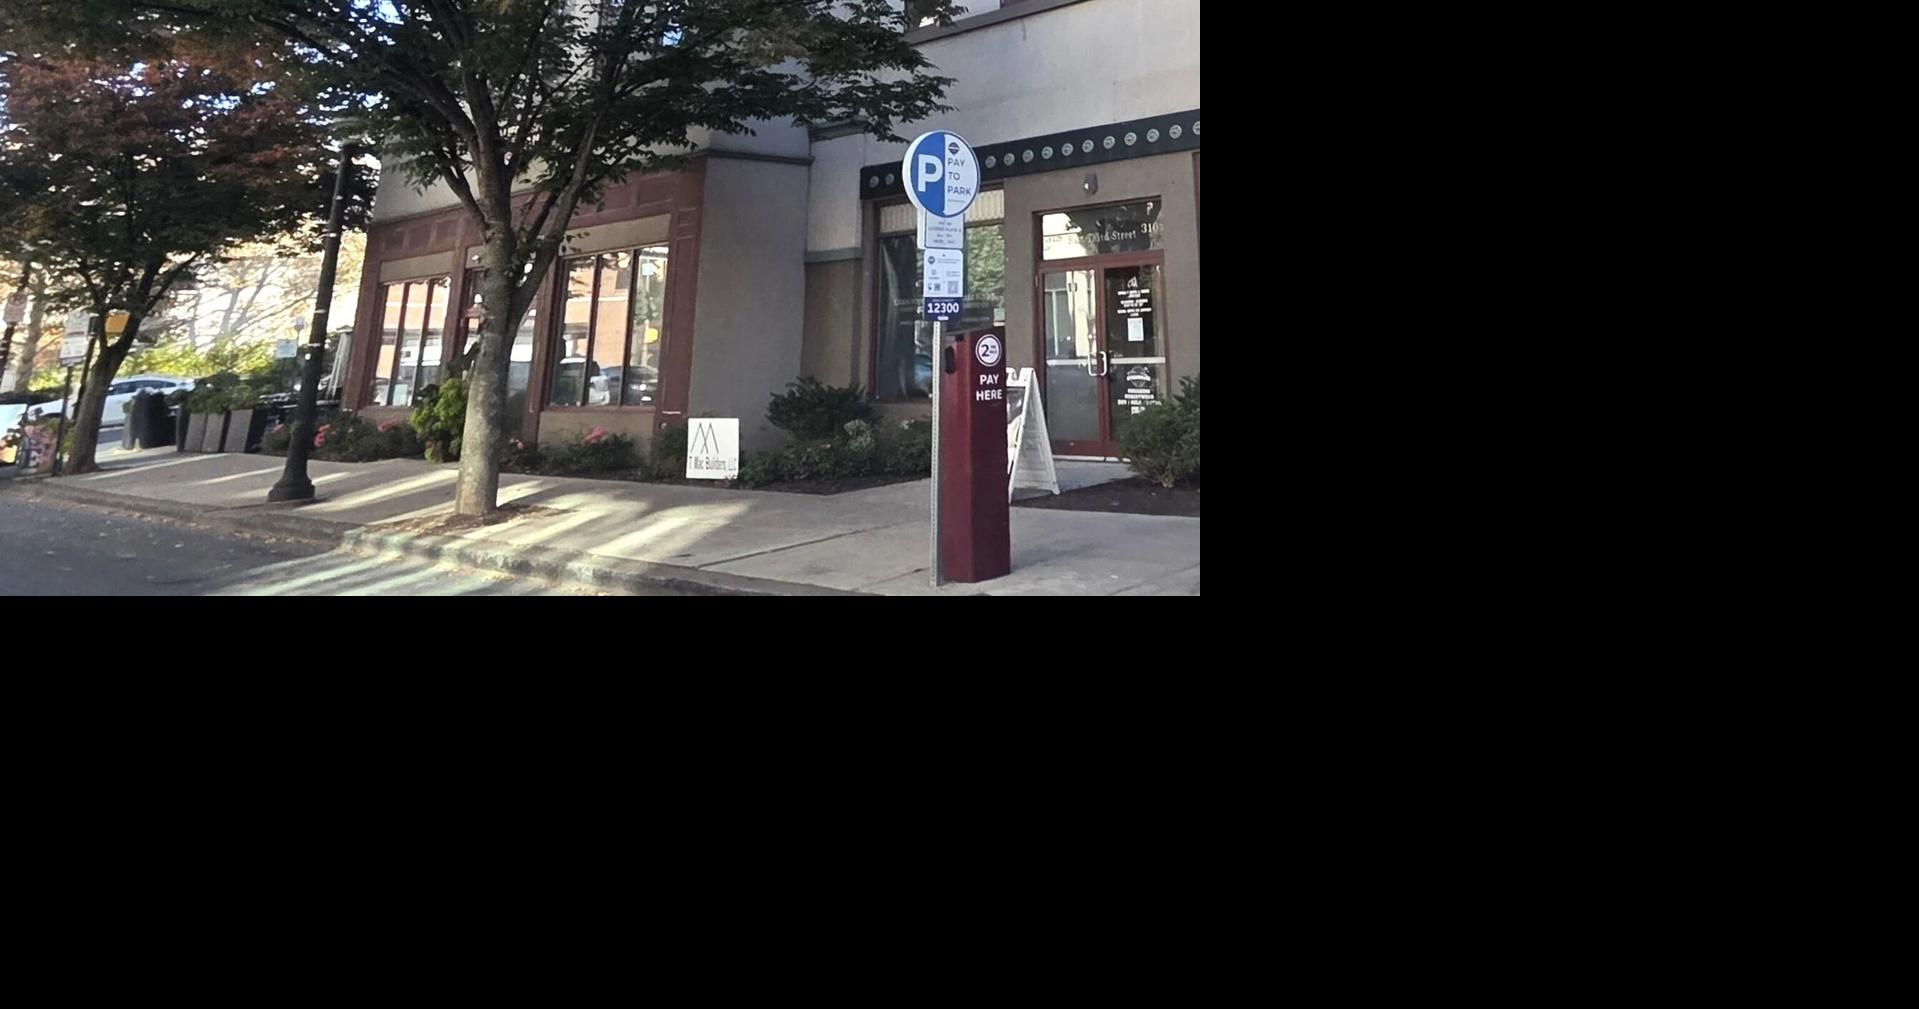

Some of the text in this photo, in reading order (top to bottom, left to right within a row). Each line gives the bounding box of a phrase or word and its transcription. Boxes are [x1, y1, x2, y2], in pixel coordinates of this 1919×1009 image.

[947, 157, 965, 167] PAY
[918, 153, 943, 192] P
[948, 171, 960, 181] TO
[947, 185, 972, 196] PARK
[1112, 230, 1136, 241] Street
[927, 302, 960, 314] 12300
[981, 344, 990, 357] 2
[979, 373, 999, 386] PAY
[976, 389, 1002, 401] HERE
